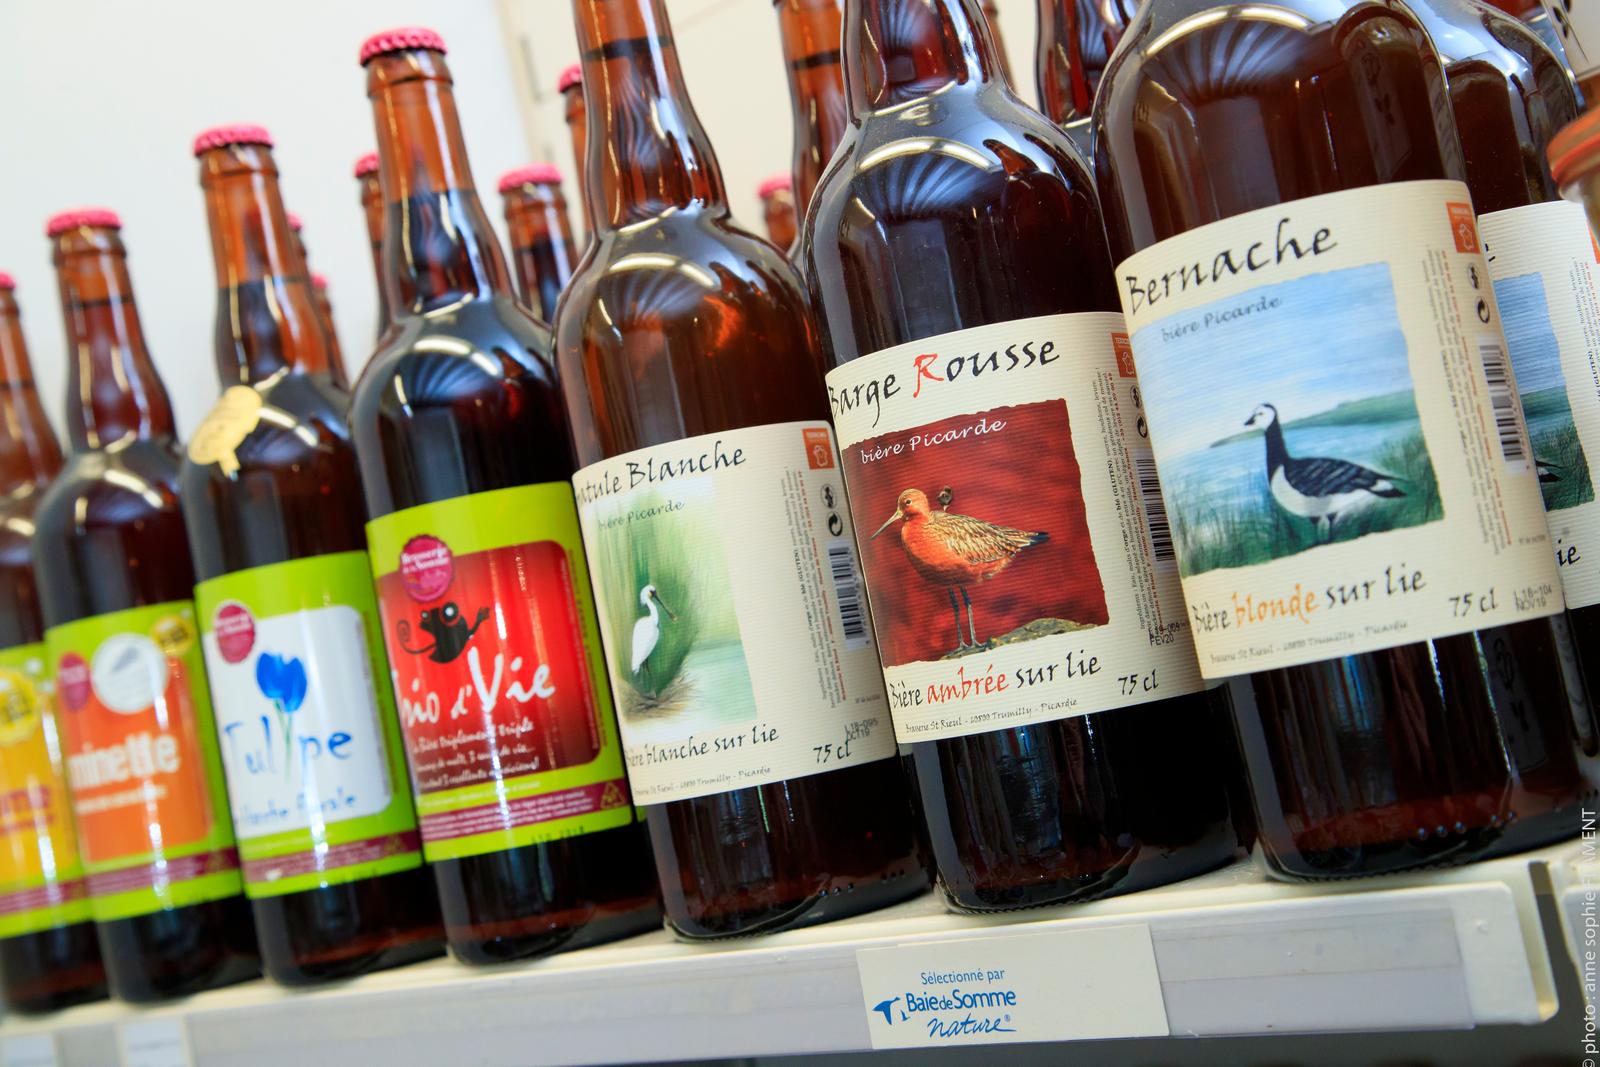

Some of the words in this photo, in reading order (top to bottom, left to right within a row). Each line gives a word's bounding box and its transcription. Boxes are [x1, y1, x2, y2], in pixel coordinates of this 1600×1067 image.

[1125, 217, 1338, 315] Bernache
[1162, 315, 1200, 343] bière
[1204, 295, 1283, 325] Picarde
[827, 370, 902, 428] Barge
[913, 338, 1061, 399] Rousse
[861, 441, 905, 465] bière
[909, 418, 1008, 451] Picarde
[576, 471, 623, 505] atule
[626, 440, 746, 489] Blanche
[1556, 538, 1581, 567] ie
[1192, 602, 1231, 635] Bière
[1232, 583, 1320, 629] blonde
[1326, 580, 1377, 610] sur
[1386, 563, 1427, 595] lie
[1449, 594, 1473, 617] 75
[1480, 588, 1499, 613] cl
[890, 681, 923, 708] Bière
[927, 664, 1010, 705] ambrée
[1015, 662, 1059, 689] sur
[1067, 650, 1102, 678] lie
[1118, 675, 1138, 696] 75
[1143, 669, 1159, 693] cl
[645, 736, 709, 764] blanche
[714, 733, 746, 755] sur
[752, 723, 779, 745] lie
[813, 747, 831, 763] 75
[837, 738, 852, 760] cl
[920, 967, 984, 985] Sélectionné
[986, 967, 1006, 984] par
